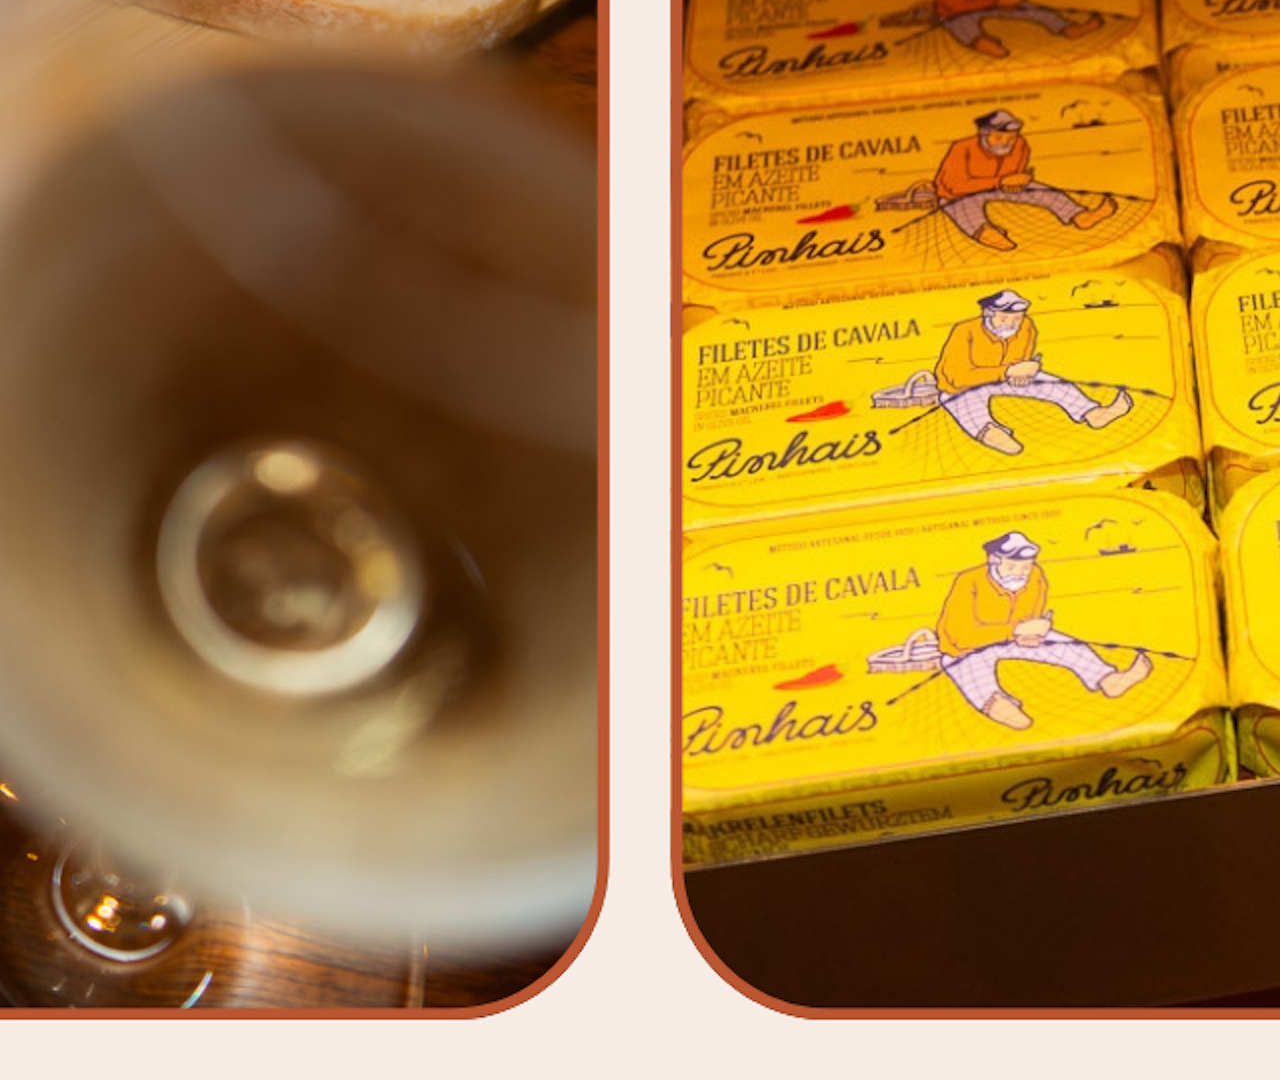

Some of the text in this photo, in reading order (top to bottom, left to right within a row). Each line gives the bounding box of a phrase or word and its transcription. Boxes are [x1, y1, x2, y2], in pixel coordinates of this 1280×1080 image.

[715, 137, 918, 171] FILETES DE CAVALA
[712, 164, 819, 190] EM AZEITE
[711, 185, 800, 208] PICANTE
[704, 230, 884, 270] Pinhais
[1241, 312, 1272, 333] EM
[700, 318, 918, 365] FILETES DE CAVALA
[697, 354, 811, 387] EM AZEITE
[695, 378, 790, 408] PICANTE
[688, 430, 880, 481] Pinhais
[787, 580, 818, 605] DE
[825, 569, 918, 600] CAVALA
[682, 637, 778, 670] ICANTE
